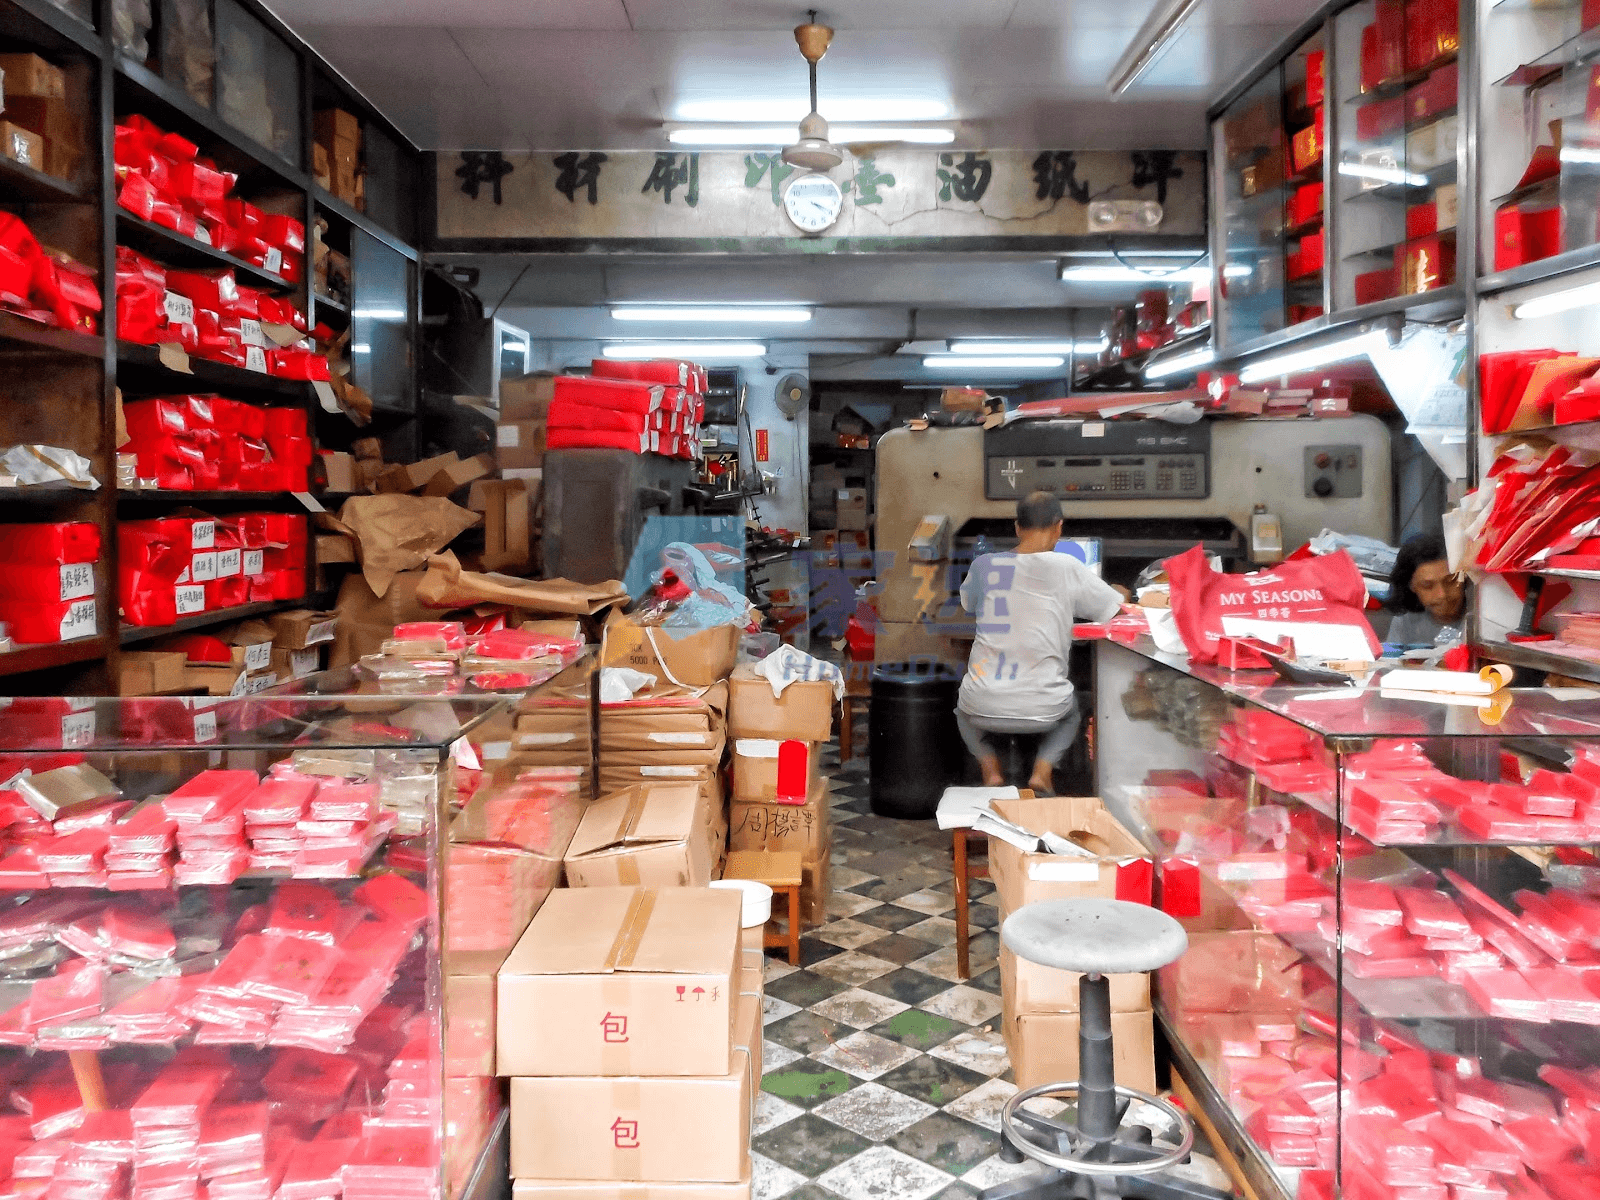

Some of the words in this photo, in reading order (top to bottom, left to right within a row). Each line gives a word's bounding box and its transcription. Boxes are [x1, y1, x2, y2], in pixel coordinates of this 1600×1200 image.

[1219, 592, 1246, 606] MY
[629, 655, 648, 665] 5000
[600, 1011, 630, 1043] 包
[610, 1116, 641, 1150] 包
